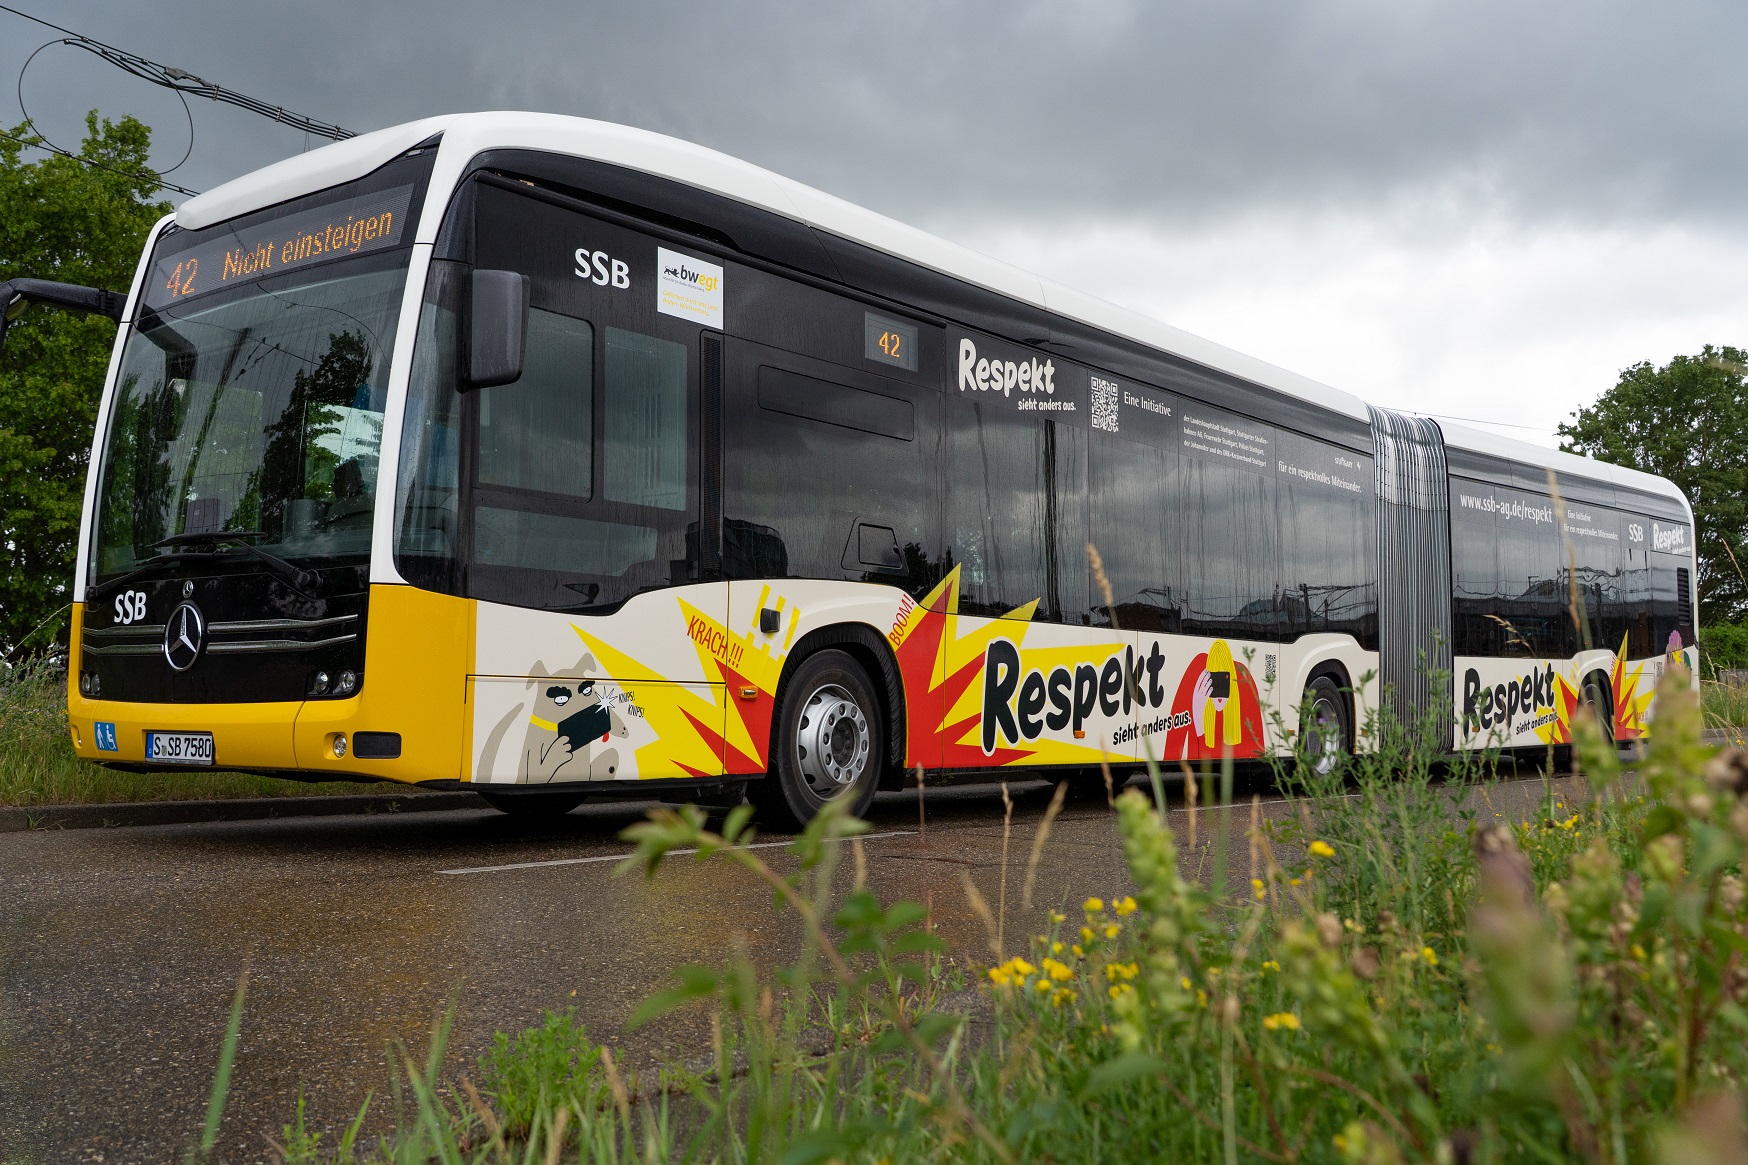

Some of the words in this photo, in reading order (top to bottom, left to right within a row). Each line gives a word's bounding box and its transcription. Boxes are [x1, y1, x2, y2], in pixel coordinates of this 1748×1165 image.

[166, 258, 198, 298] 42
[222, 241, 275, 281] Nicht
[281, 211, 393, 264] einsteigen
[574, 248, 630, 289] SSB
[681, 265, 718, 292] bwegt
[879, 331, 901, 358] 42
[958, 338, 1055, 398] Respekt
[1018, 398, 1038, 411] sieht
[1038, 398, 1062, 411] anders
[1063, 401, 1077, 411] aus.
[1124, 391, 1139, 408] Eine
[1141, 395, 1172, 417] Initiative
[1278, 460, 1287, 473] für
[1288, 464, 1297, 476] ein
[1297, 468, 1331, 485] respektvolles
[1331, 475, 1362, 493] Miteinander.
[1460, 494, 1553, 525] www.ssb-ag.de/respekt
[1628, 523, 1644, 542] SSB
[1653, 522, 1685, 551] Respekt
[113, 589, 147, 625] SSB
[888, 593, 915, 647] BOOM!
[618, 690, 636, 703] KNIPS!
[627, 704, 646, 718] KNIPS!
[983, 640, 1166, 754] Respekt
[1462, 662, 1556, 738] Respekt
[1113, 722, 1139, 746] sieht
[1141, 716, 1173, 738] anders
[1173, 711, 1192, 728] aus.
[1516, 719, 1530, 735] sieht
[1530, 714, 1548, 729] anders
[153, 736, 161, 756] S
[167, 736, 182, 757] SB
[184, 737, 212, 758] 7580
